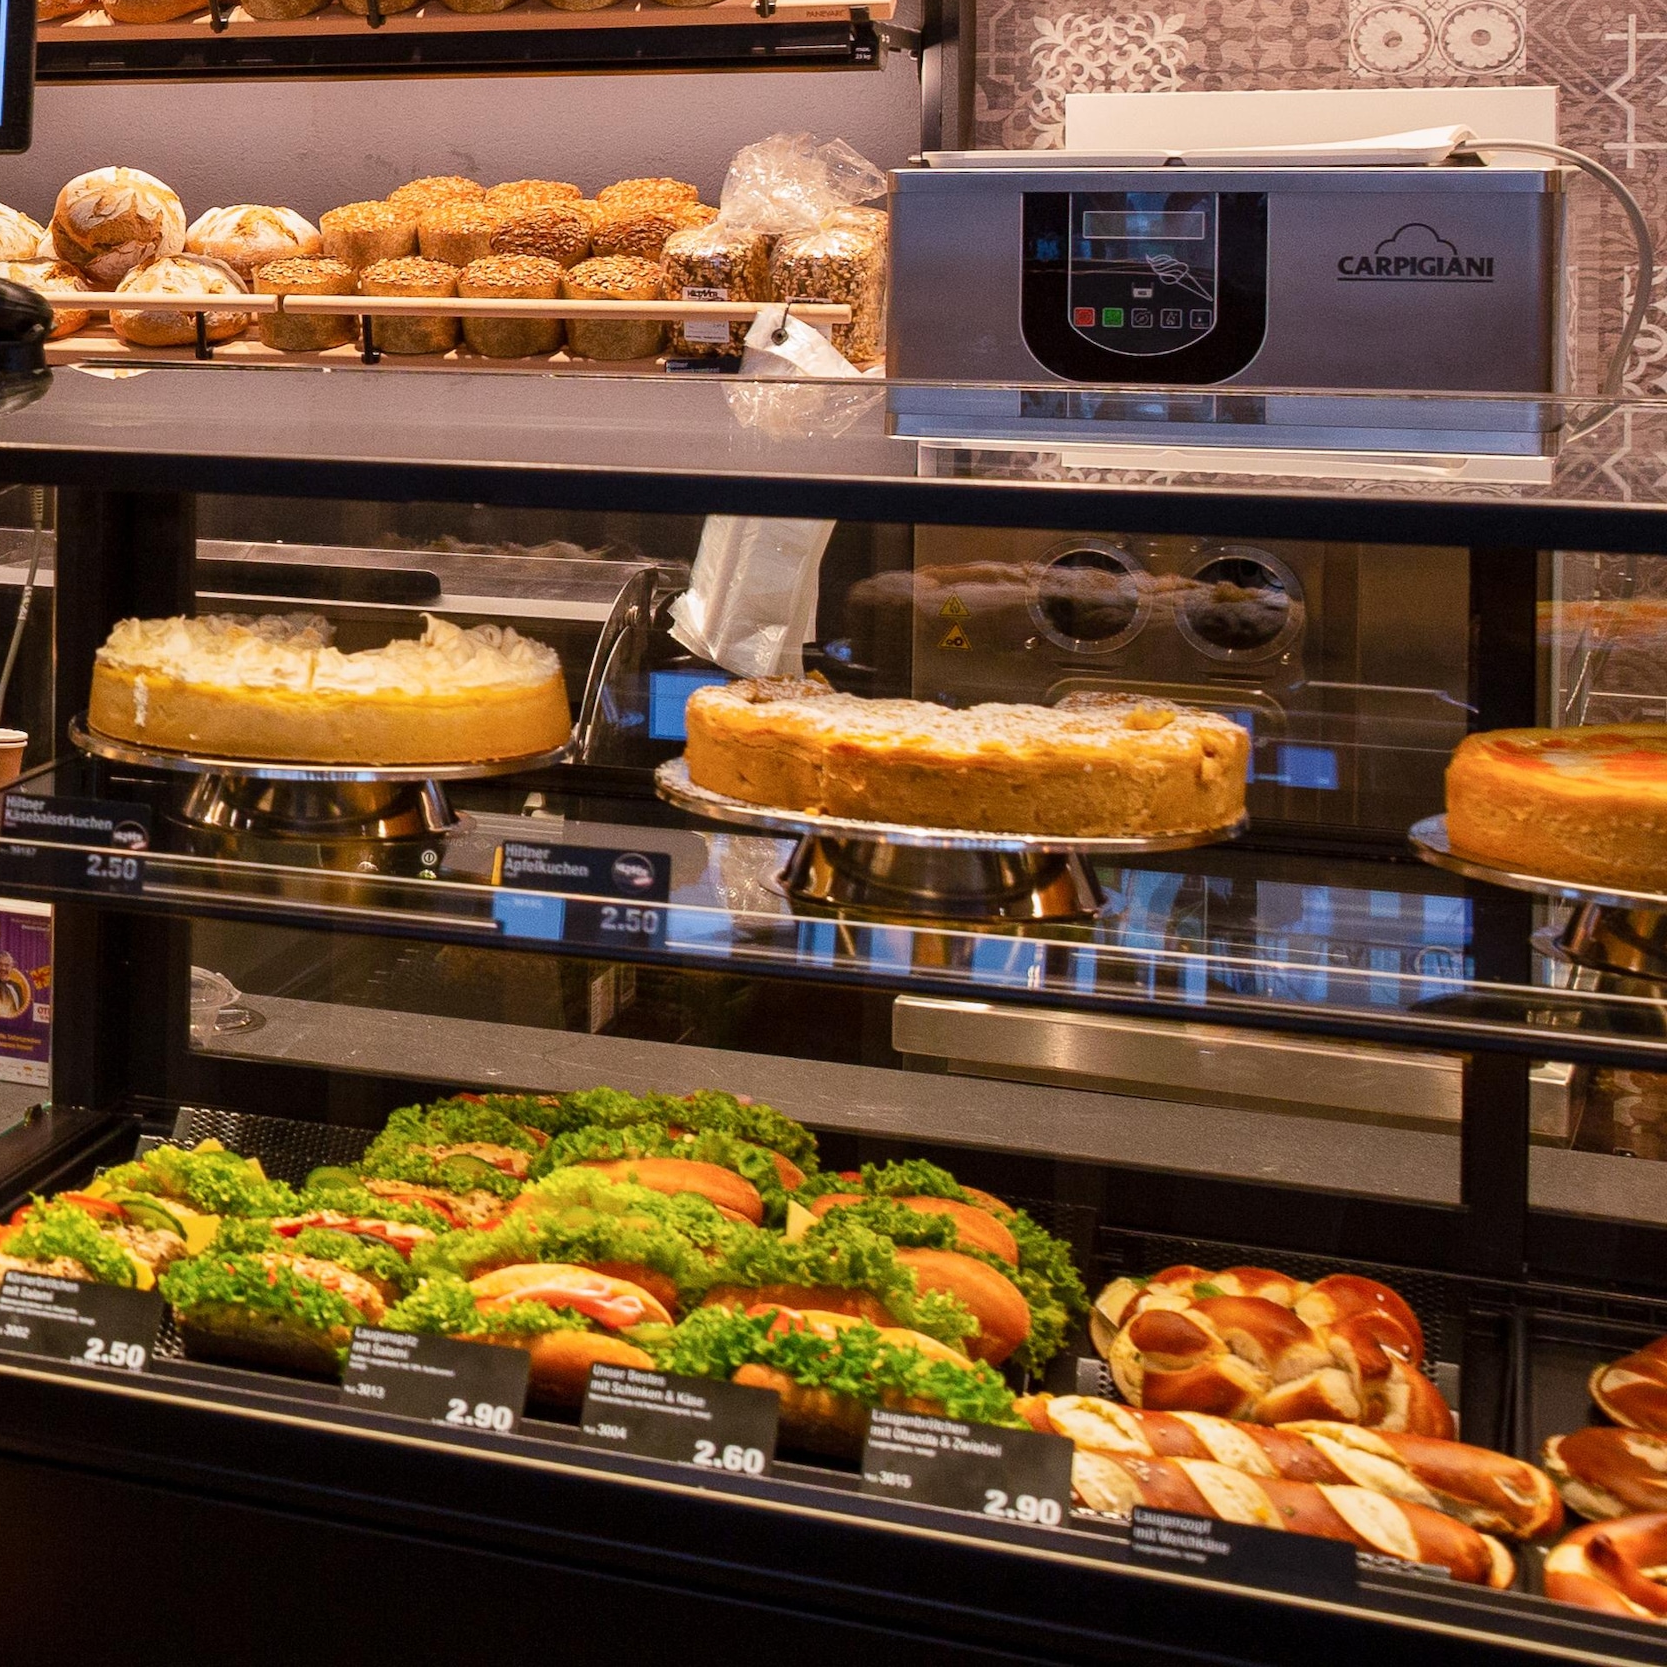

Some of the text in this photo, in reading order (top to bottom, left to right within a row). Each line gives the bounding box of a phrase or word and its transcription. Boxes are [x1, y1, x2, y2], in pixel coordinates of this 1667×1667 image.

[1337, 255, 1495, 278] CARPIGIANI
[5, 795, 47, 812] Hiltner
[4, 810, 113, 831] Käsebaiserkuchen
[504, 842, 551, 860] Hiltner
[86, 853, 138, 881] 2.50
[503, 858, 590, 880] Apfelkuchen
[600, 904, 659, 933] 2.50
[354, 1326, 420, 1348] Laugenspitz
[83, 1336, 146, 1369] 2.50
[352, 1339, 410, 1361] mit Salami
[592, 1364, 666, 1388] Unser Bestes
[356, 1382, 386, 1399] 3013
[590, 1378, 612, 1394] mit
[611, 1381, 664, 1403] Schinken
[664, 1391, 676, 1405] &
[676, 1391, 707, 1409] Käse
[444, 1397, 514, 1432] 2.90
[872, 1411, 971, 1437] Laugenbrötchen
[596, 1422, 628, 1440] 3004
[869, 1423, 891, 1440] mit
[938, 1434, 951, 1449] &
[950, 1434, 1004, 1458] Zwiebel
[692, 1438, 765, 1474] 2.60
[982, 1487, 1063, 1526] 2.90
[1132, 1526, 1157, 1542] mit
[1133, 1509, 1213, 1536] Laugenzopf
